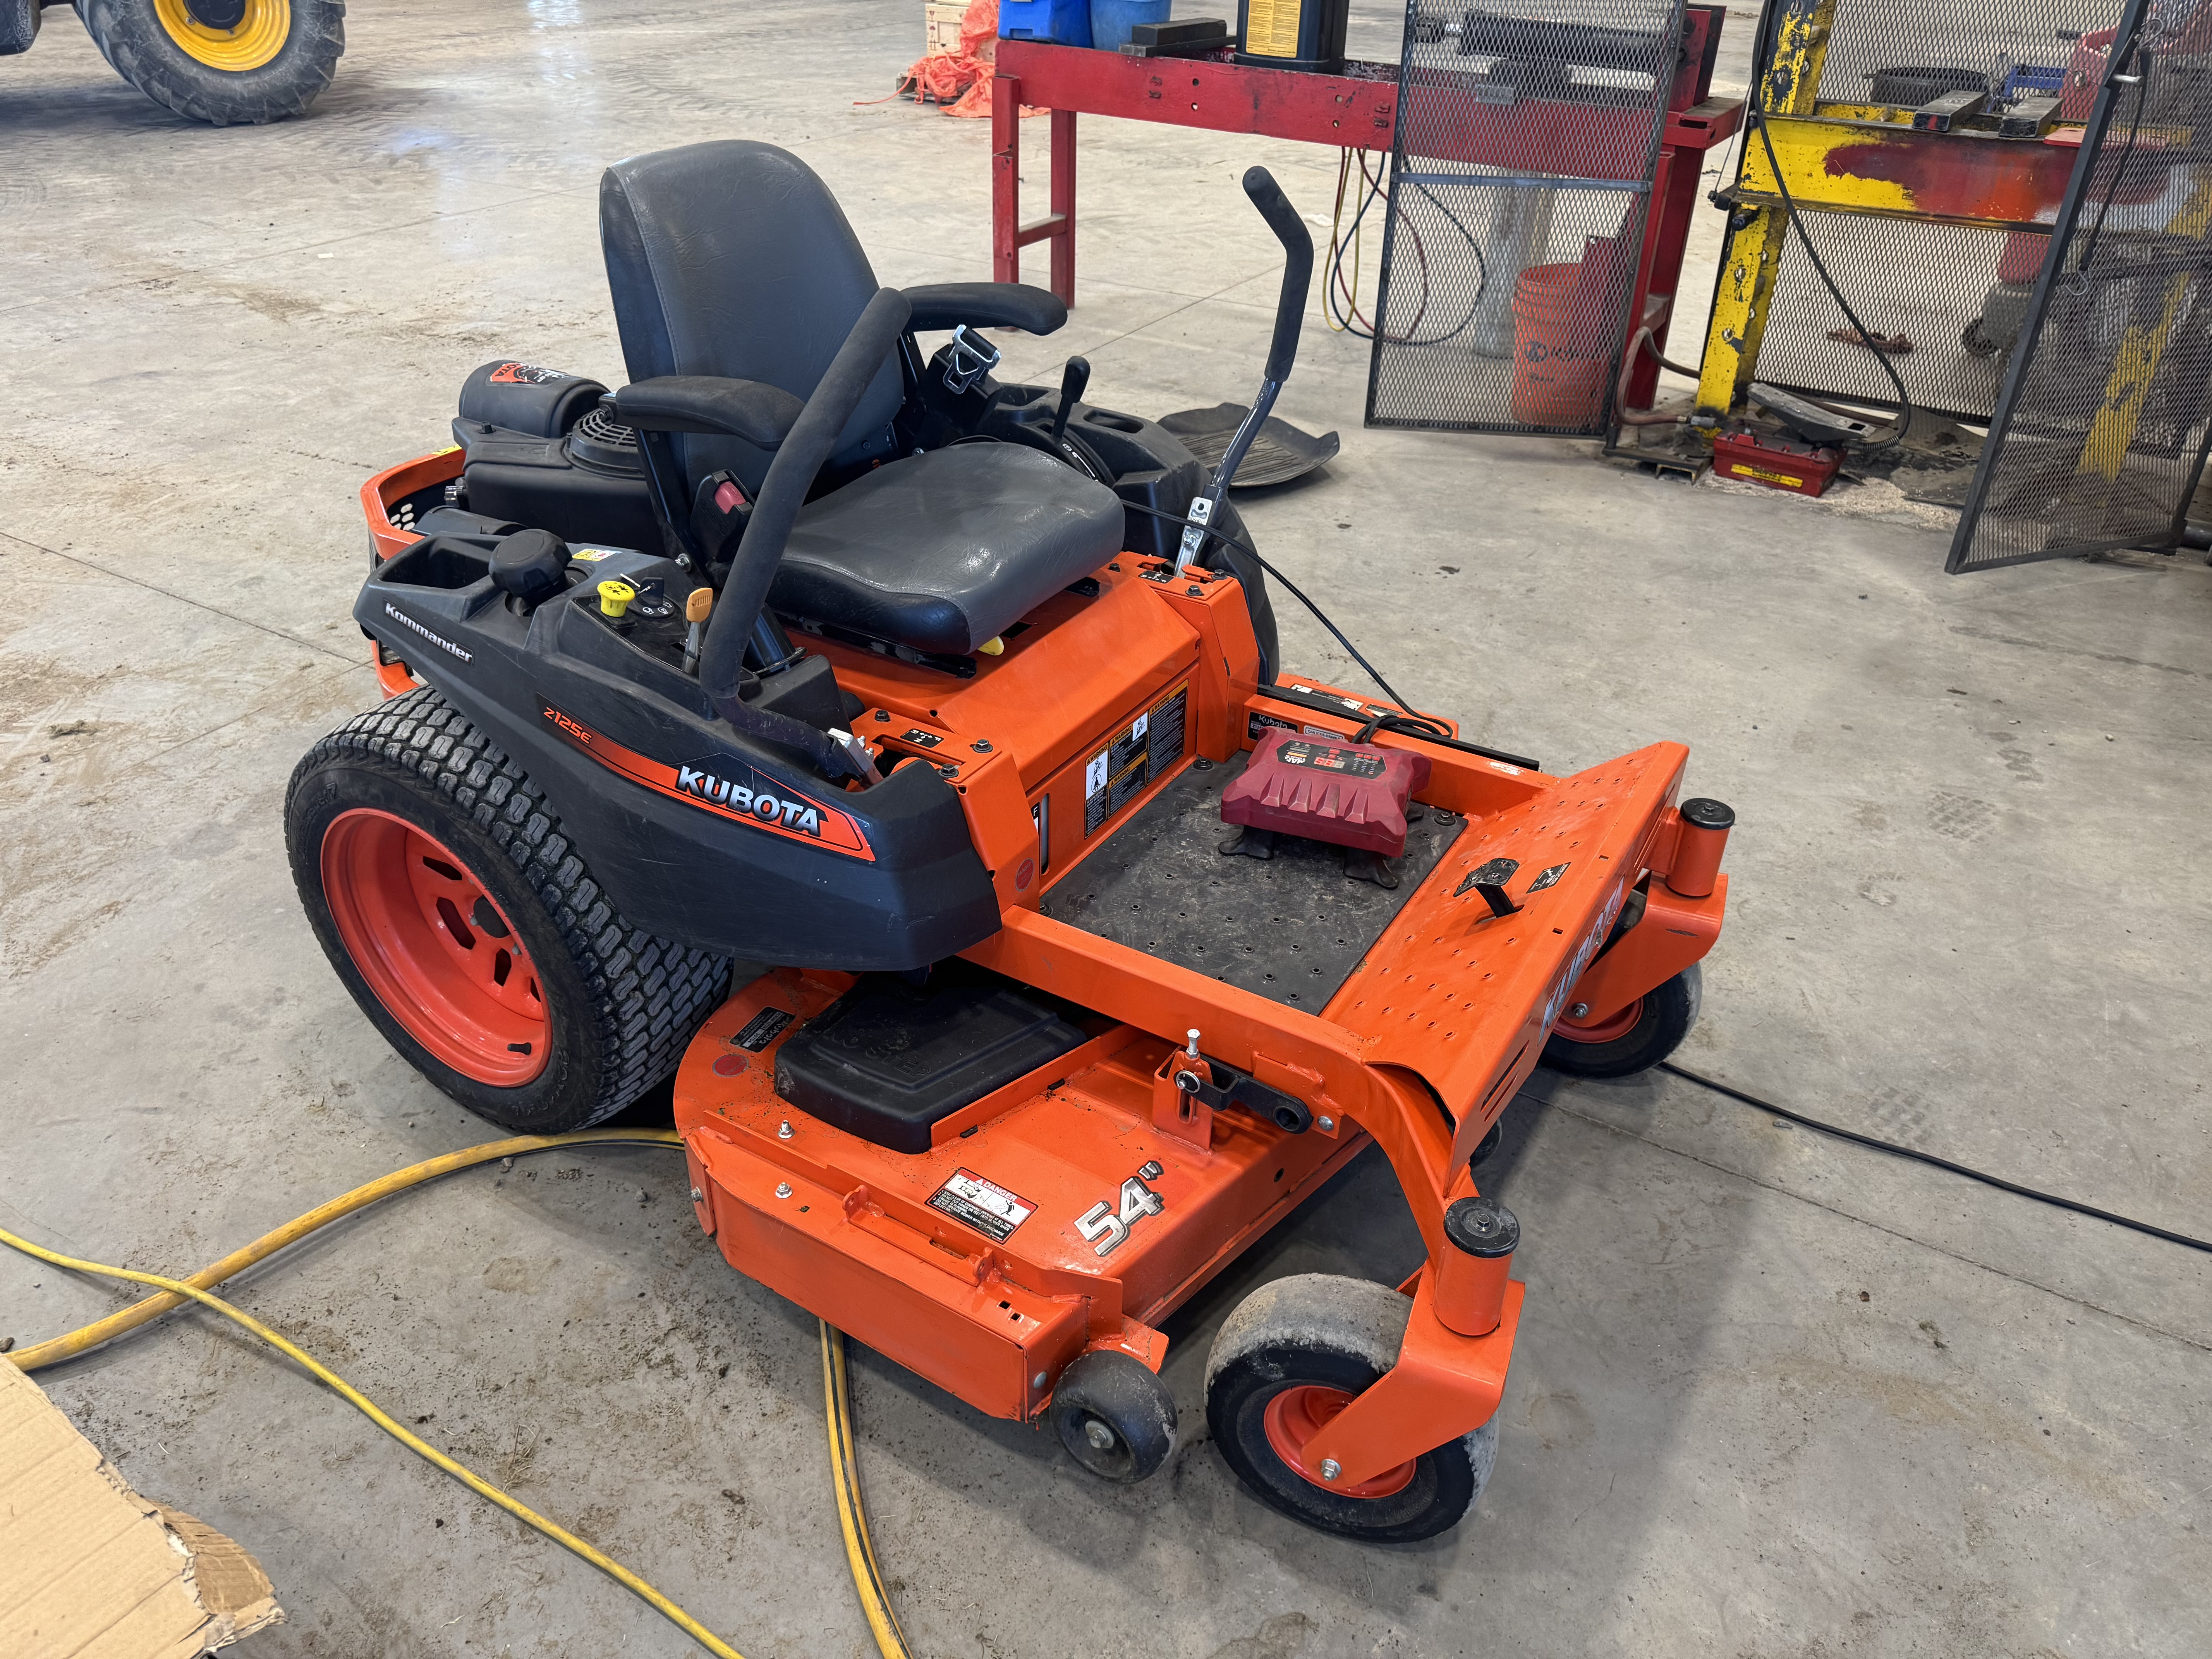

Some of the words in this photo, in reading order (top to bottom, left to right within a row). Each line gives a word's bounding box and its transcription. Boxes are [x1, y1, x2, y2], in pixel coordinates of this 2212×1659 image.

[385, 603, 472, 662] Kommander
[1154, 695, 1170, 710] WARNING
[1259, 714, 1288, 728] Kubota
[1115, 725, 1132, 742] WARNING
[1090, 745, 1107, 763] WARNING
[1114, 767, 1130, 783] WARNING
[677, 766, 822, 836] KUBOTA
[1033, 806, 1038, 816] F
[1537, 876, 1625, 1046] KUBOTA
[758, 1022, 787, 1045] Kubota
[982, 1181, 1018, 1202] DANGER
[946, 1204, 962, 1214] OPERATE
[959, 1211, 974, 1220] MOWER
[985, 1224, 1005, 1237] DISCHARGE
